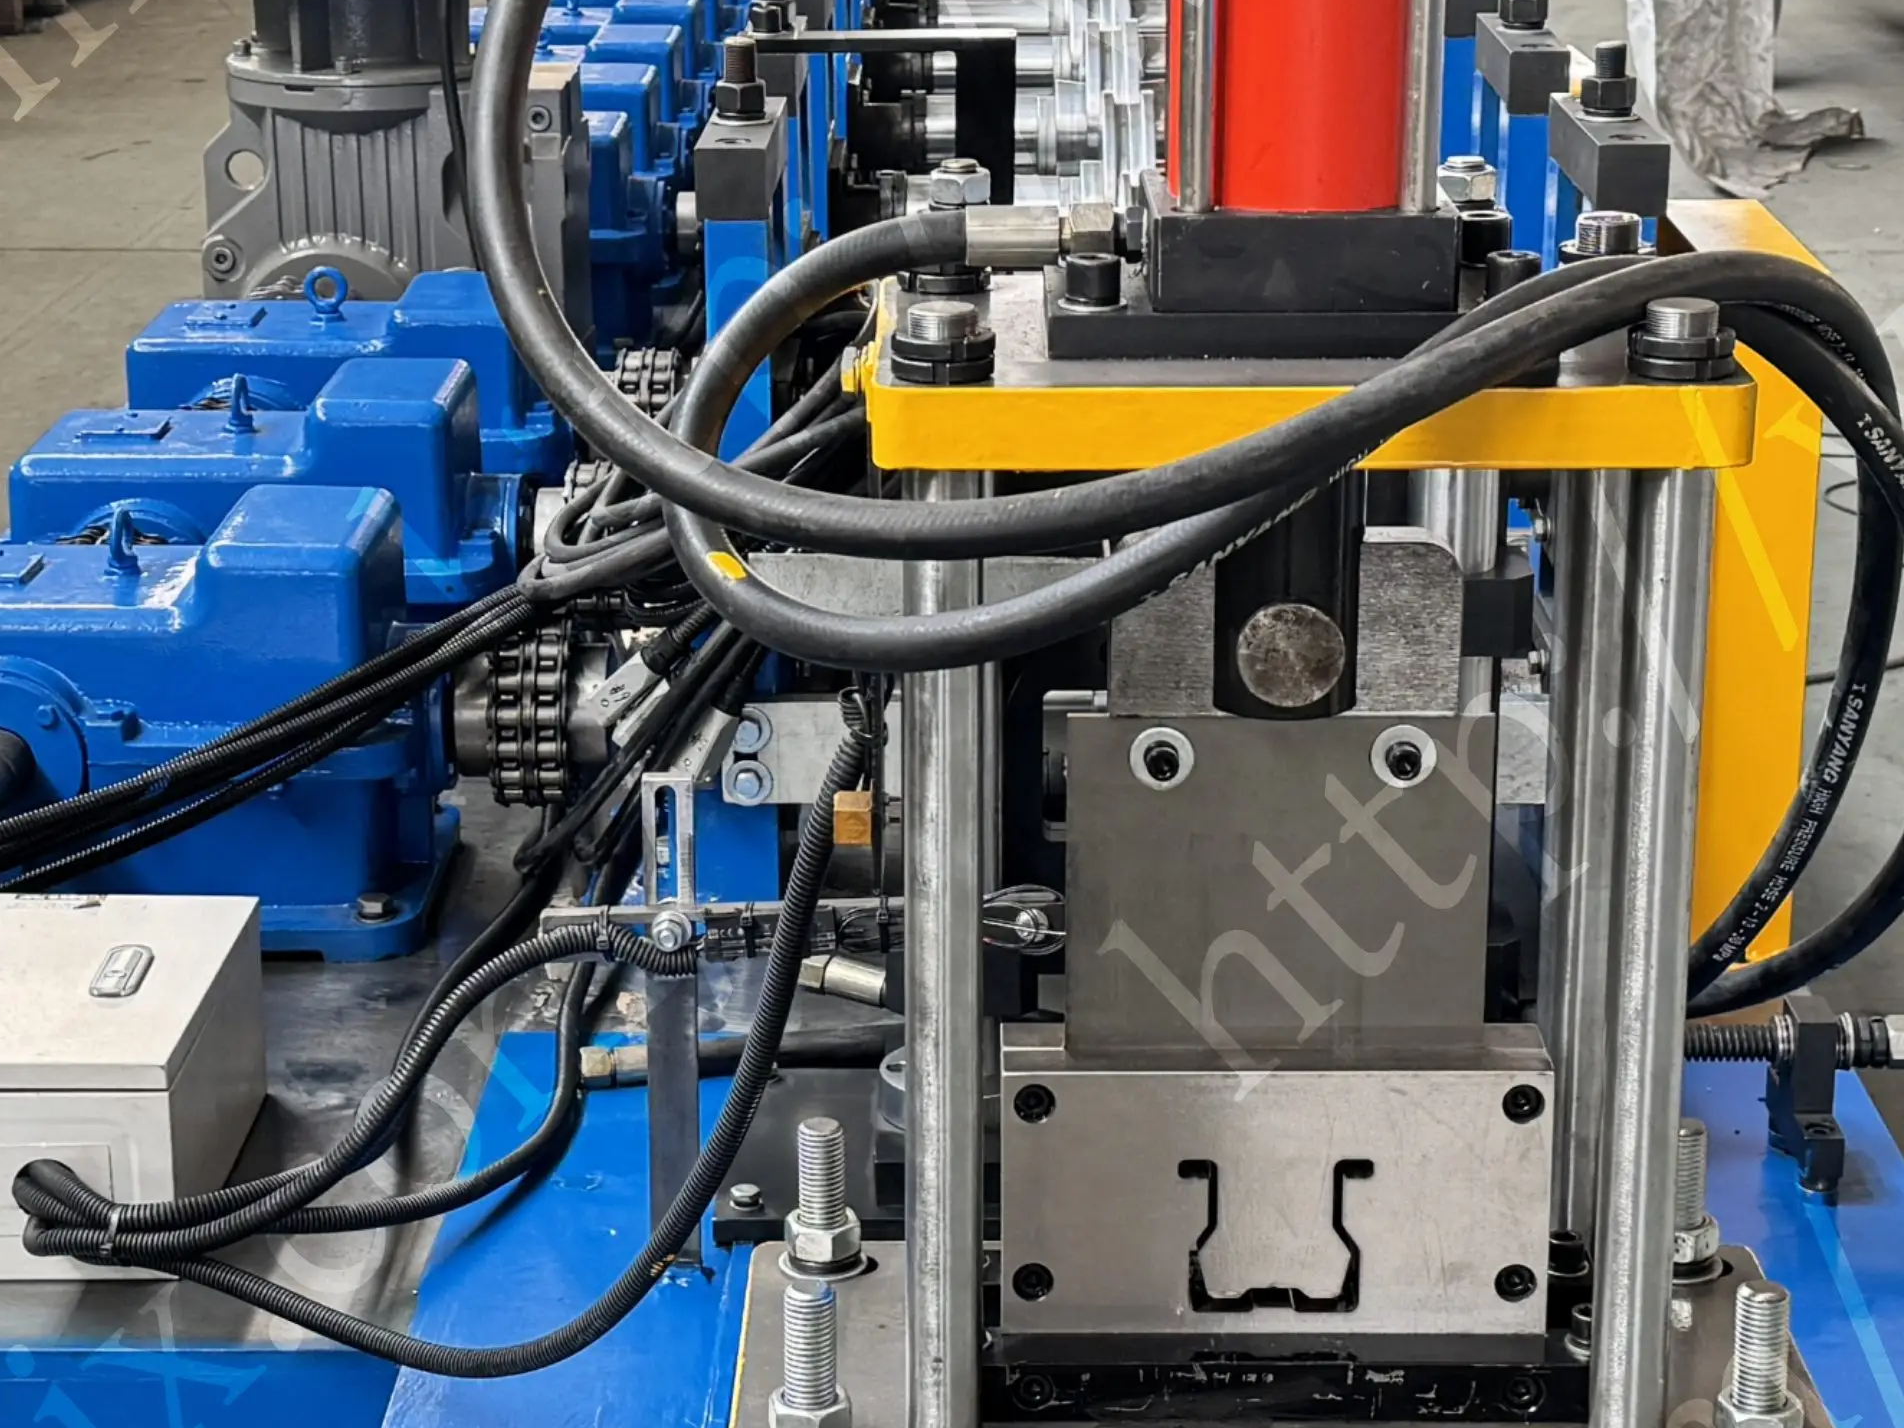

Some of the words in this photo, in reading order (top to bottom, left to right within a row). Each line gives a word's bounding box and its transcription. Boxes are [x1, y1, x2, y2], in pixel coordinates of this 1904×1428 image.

[1822, 693, 1865, 785] SANYANG
[1811, 785, 1833, 817] HIGH
[1780, 819, 1819, 874] PRESSURE
